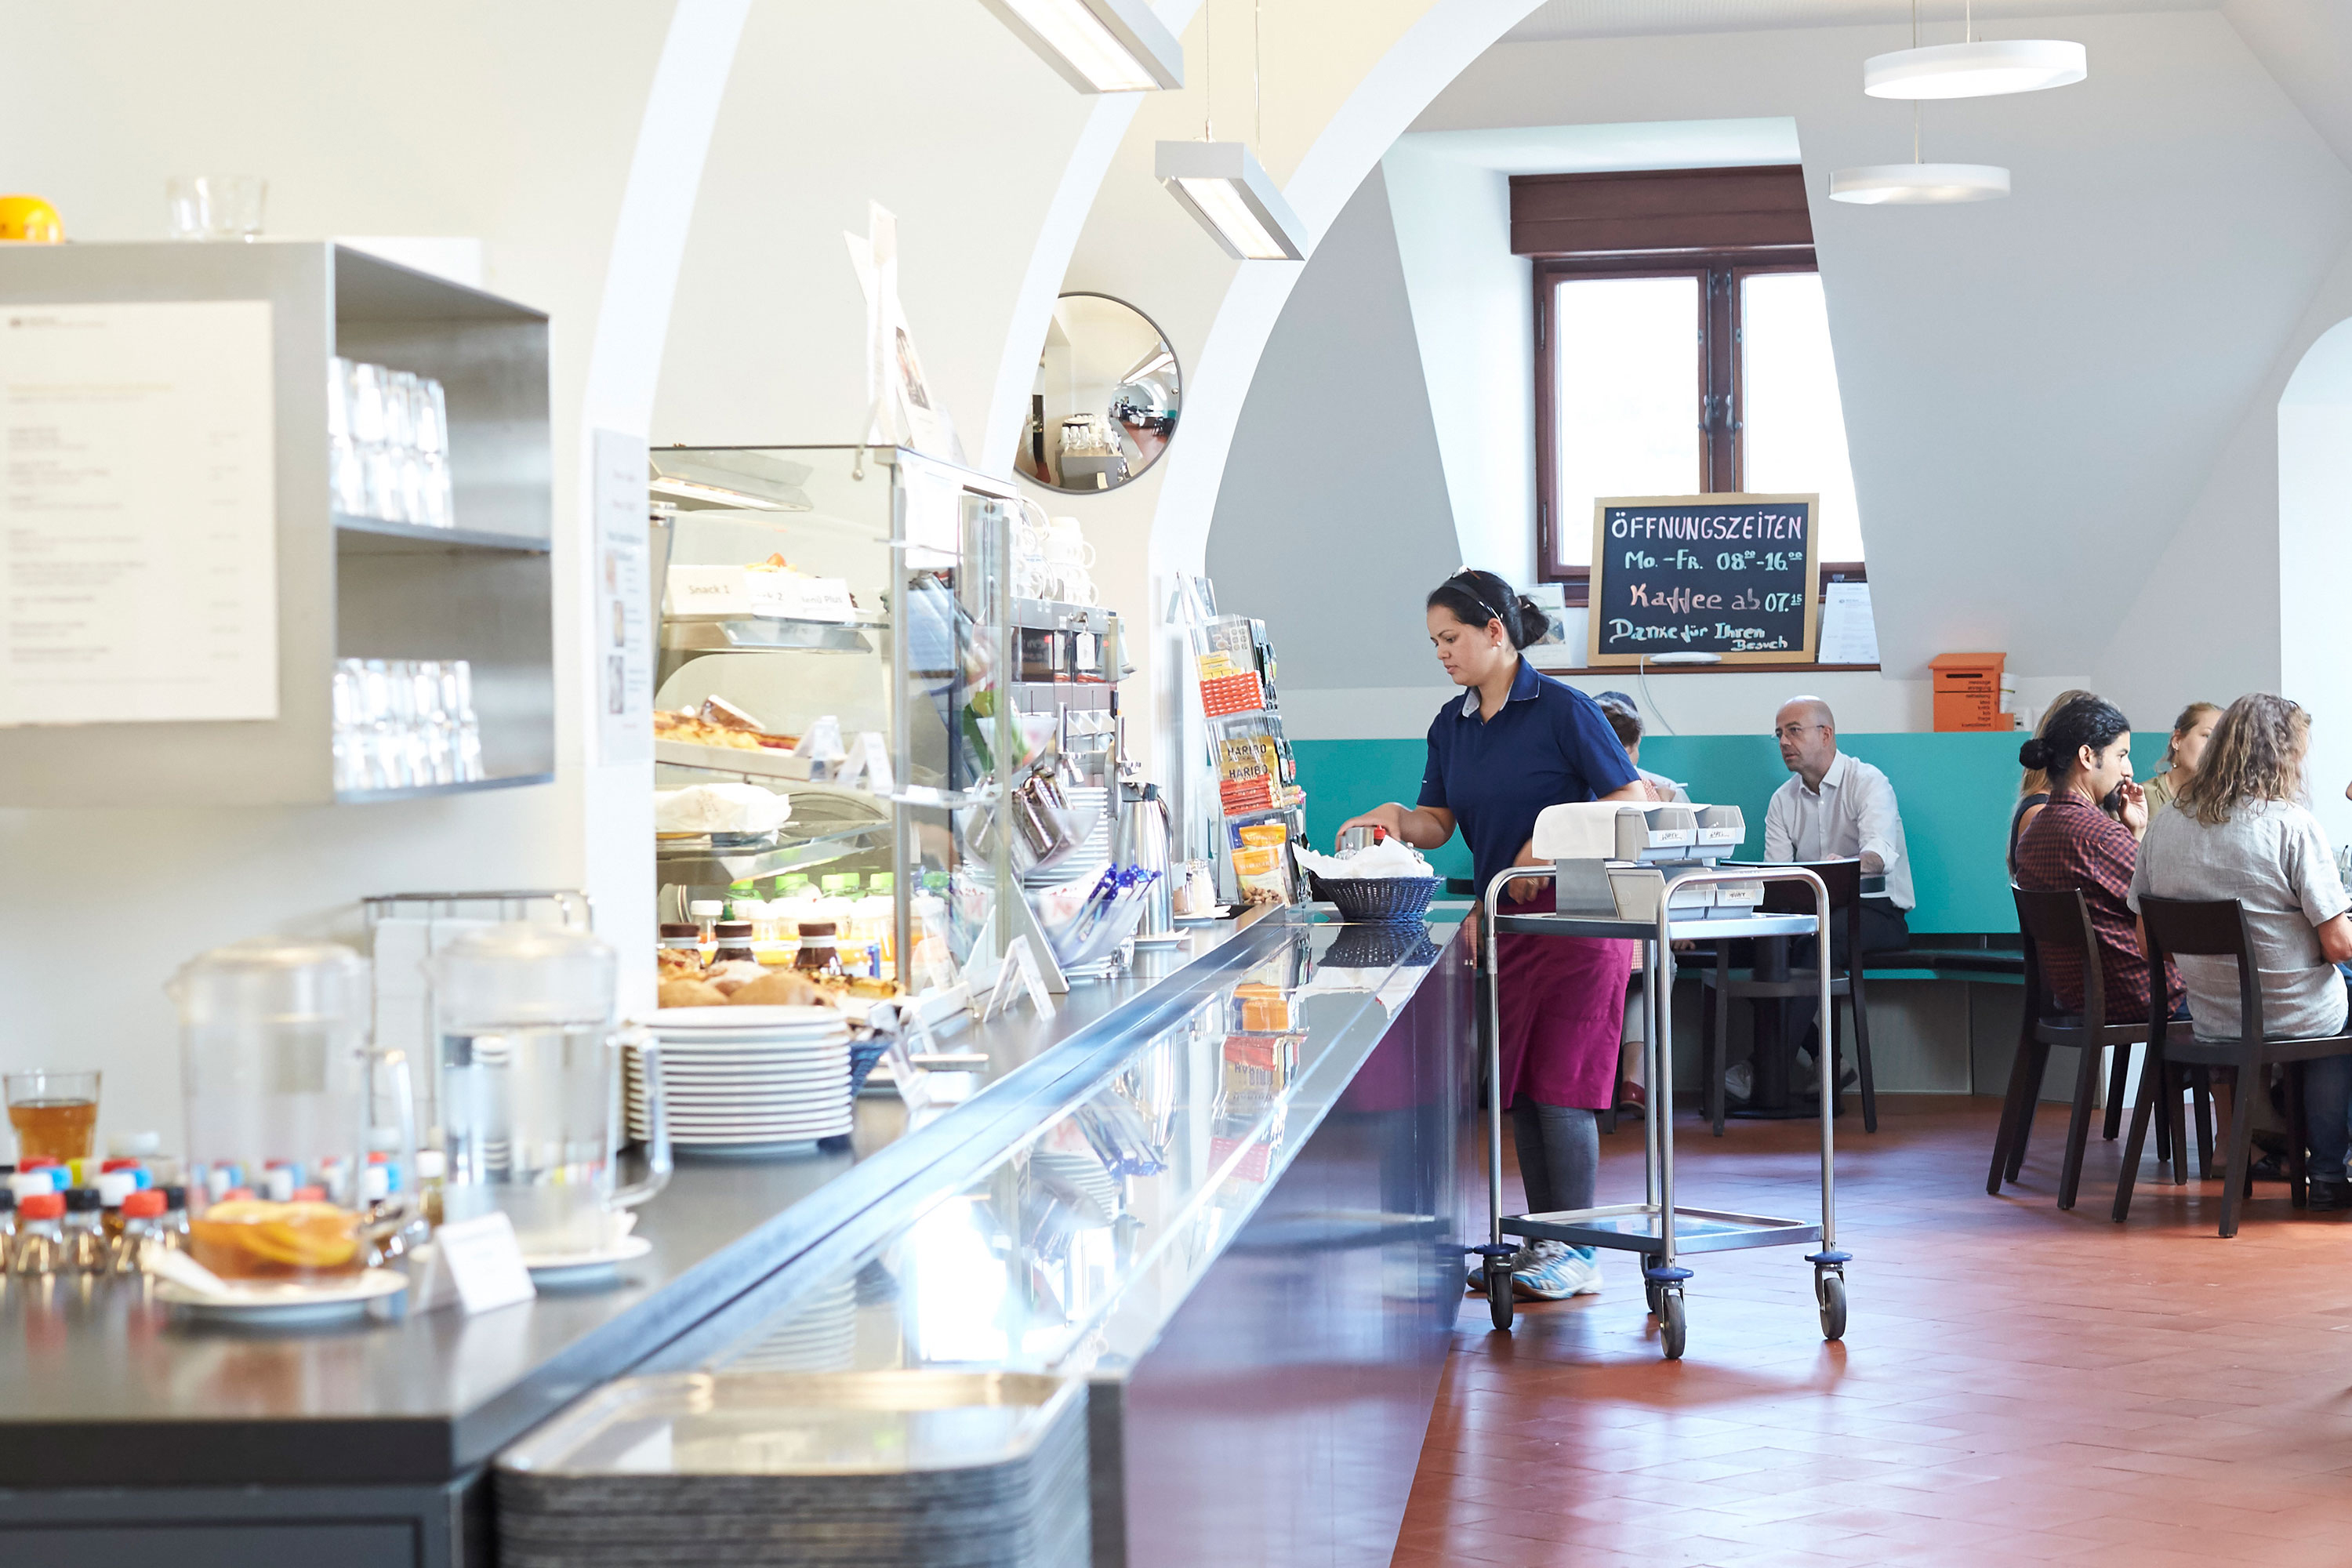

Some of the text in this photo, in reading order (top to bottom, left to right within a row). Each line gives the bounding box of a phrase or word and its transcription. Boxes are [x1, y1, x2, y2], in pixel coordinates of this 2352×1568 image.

[1611, 511, 1802, 540] ÖFFNUNGSZEITEN
[688, 585, 720, 595] Snack
[1630, 583, 1723, 614] Kaffee
[1609, 618, 1766, 644] Danke für Ihren
[1730, 635, 1788, 652] Besuch
[1229, 764, 1269, 779] HARIBO
